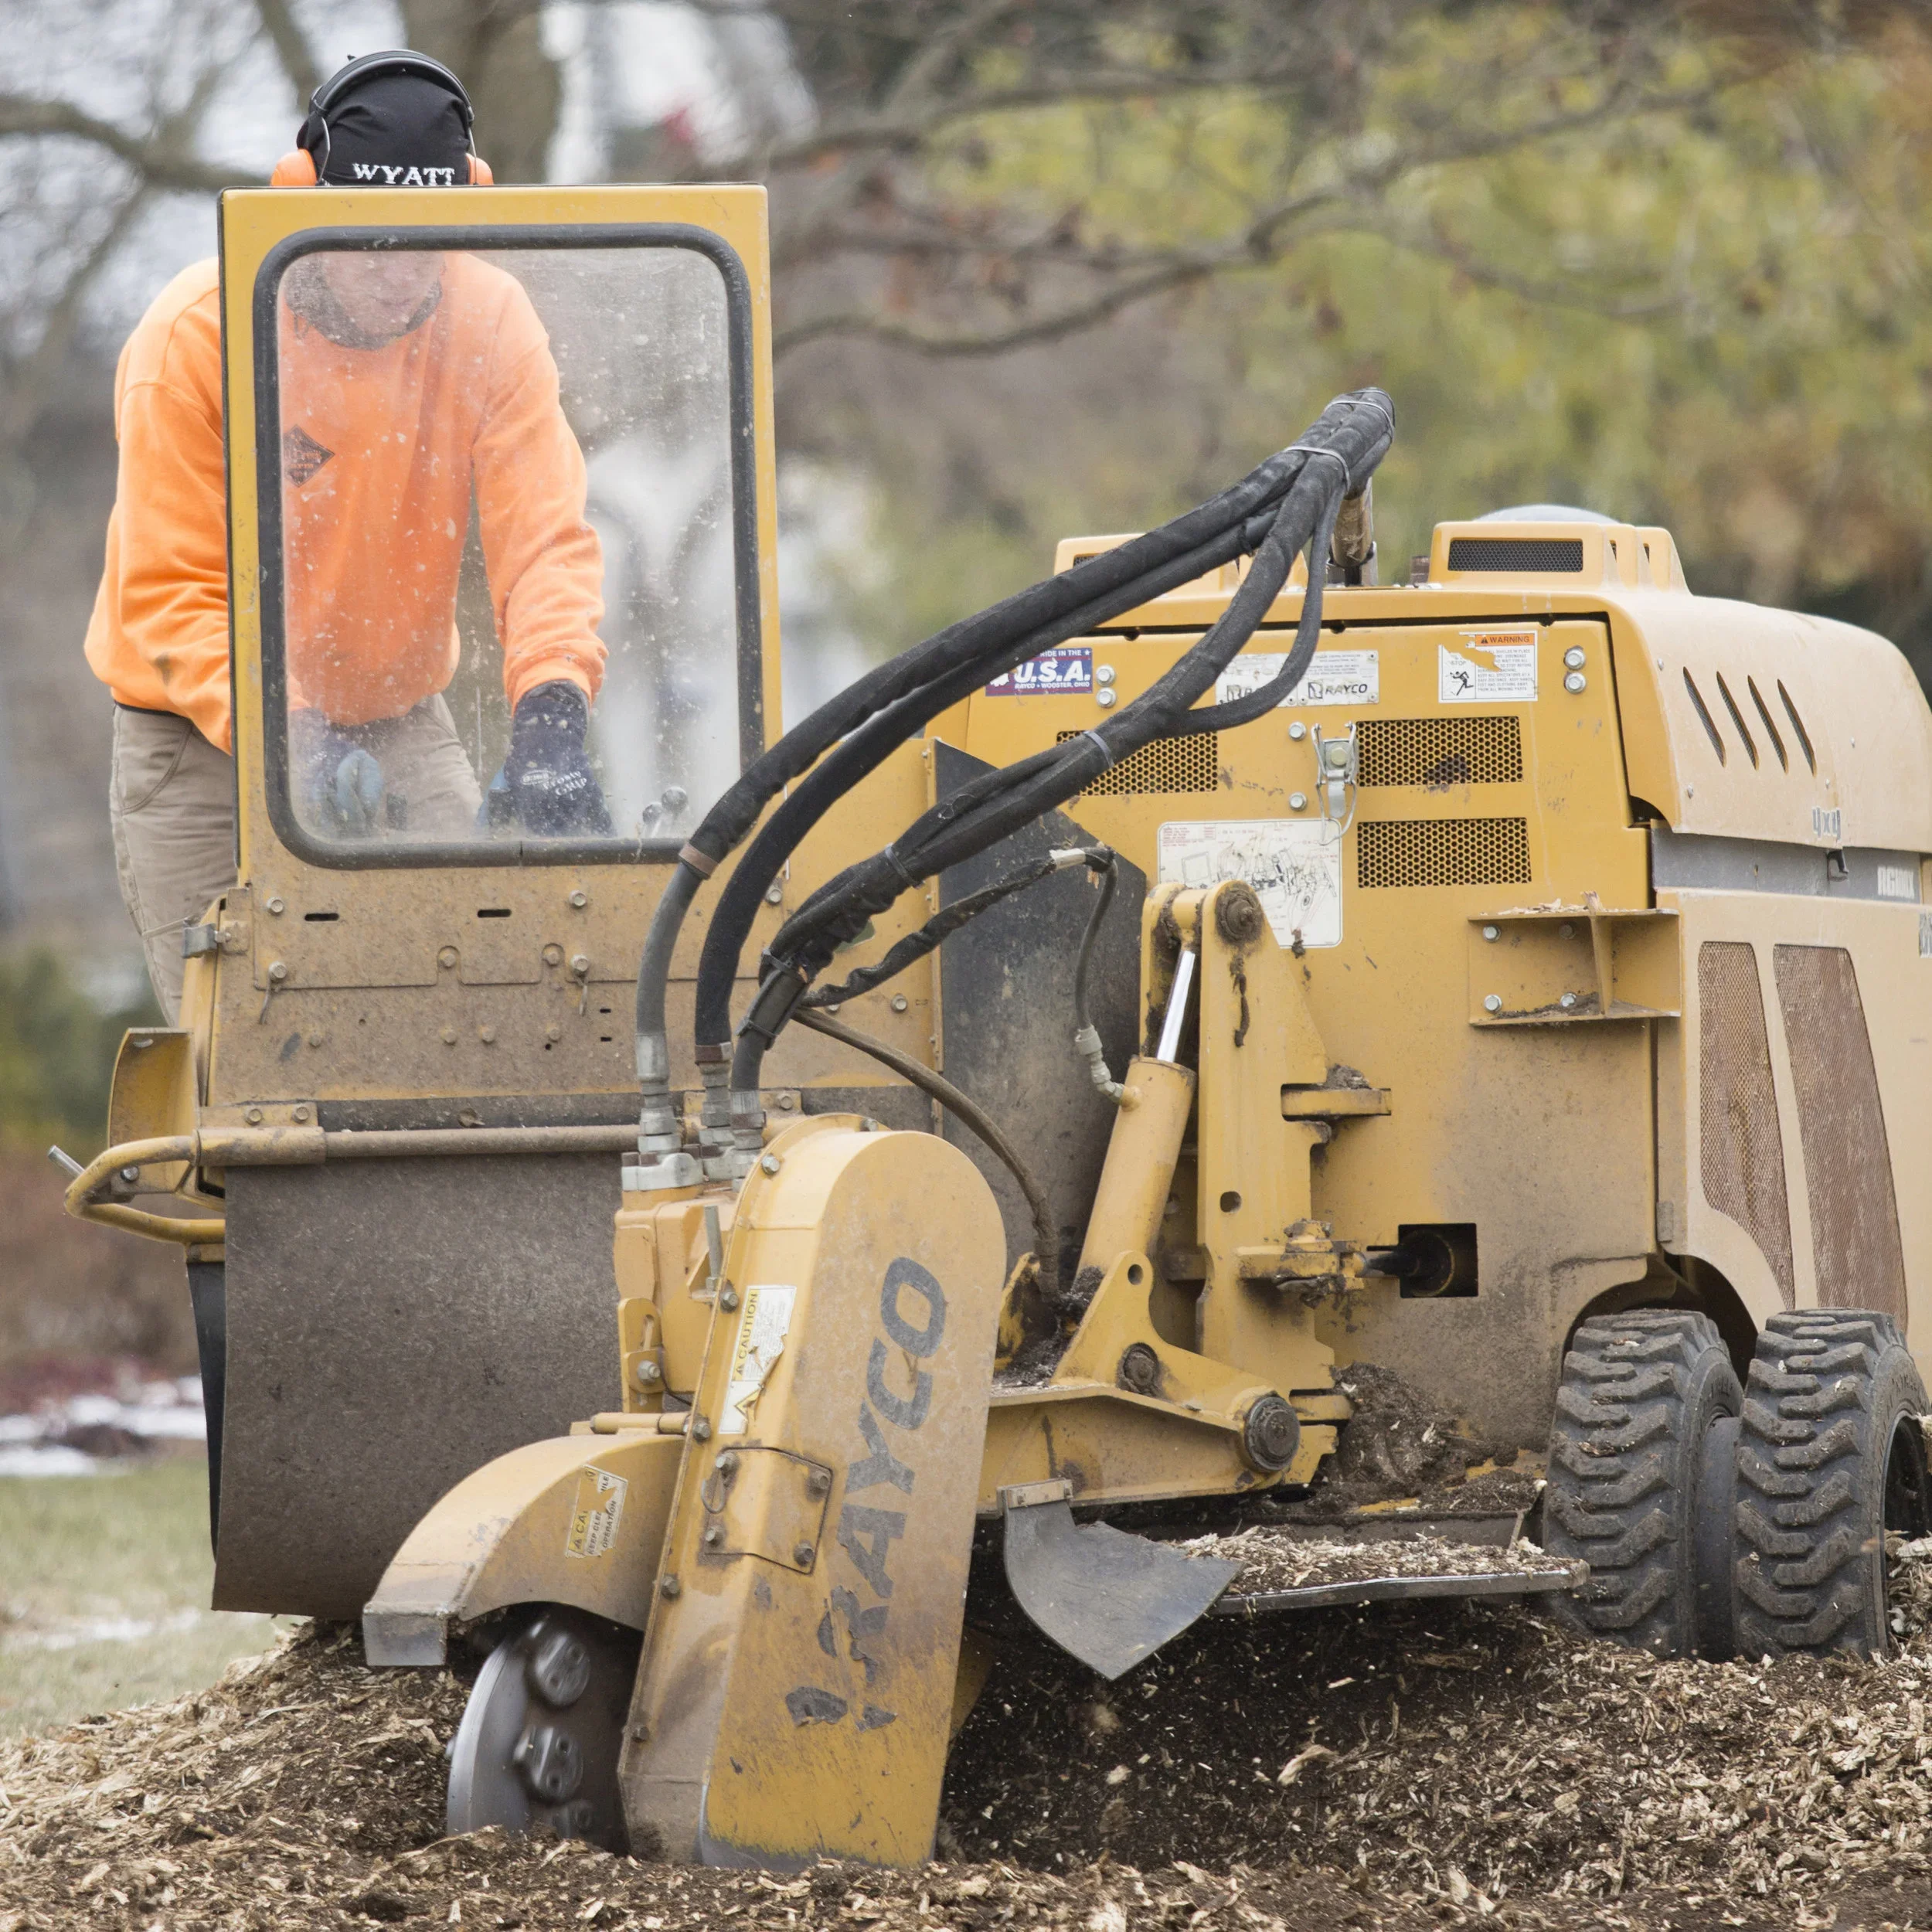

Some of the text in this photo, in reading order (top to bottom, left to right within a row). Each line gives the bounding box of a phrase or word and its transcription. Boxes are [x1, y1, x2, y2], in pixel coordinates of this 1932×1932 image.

[352, 162, 454, 186] WYATT
[1489, 635, 1530, 644] WARNING
[1014, 660, 1091, 683] U.S.A.
[1325, 684, 1368, 695] RAYCO
[739, 1293, 758, 1359] CAUTION
[602, 1500, 617, 1548] OPERATION
